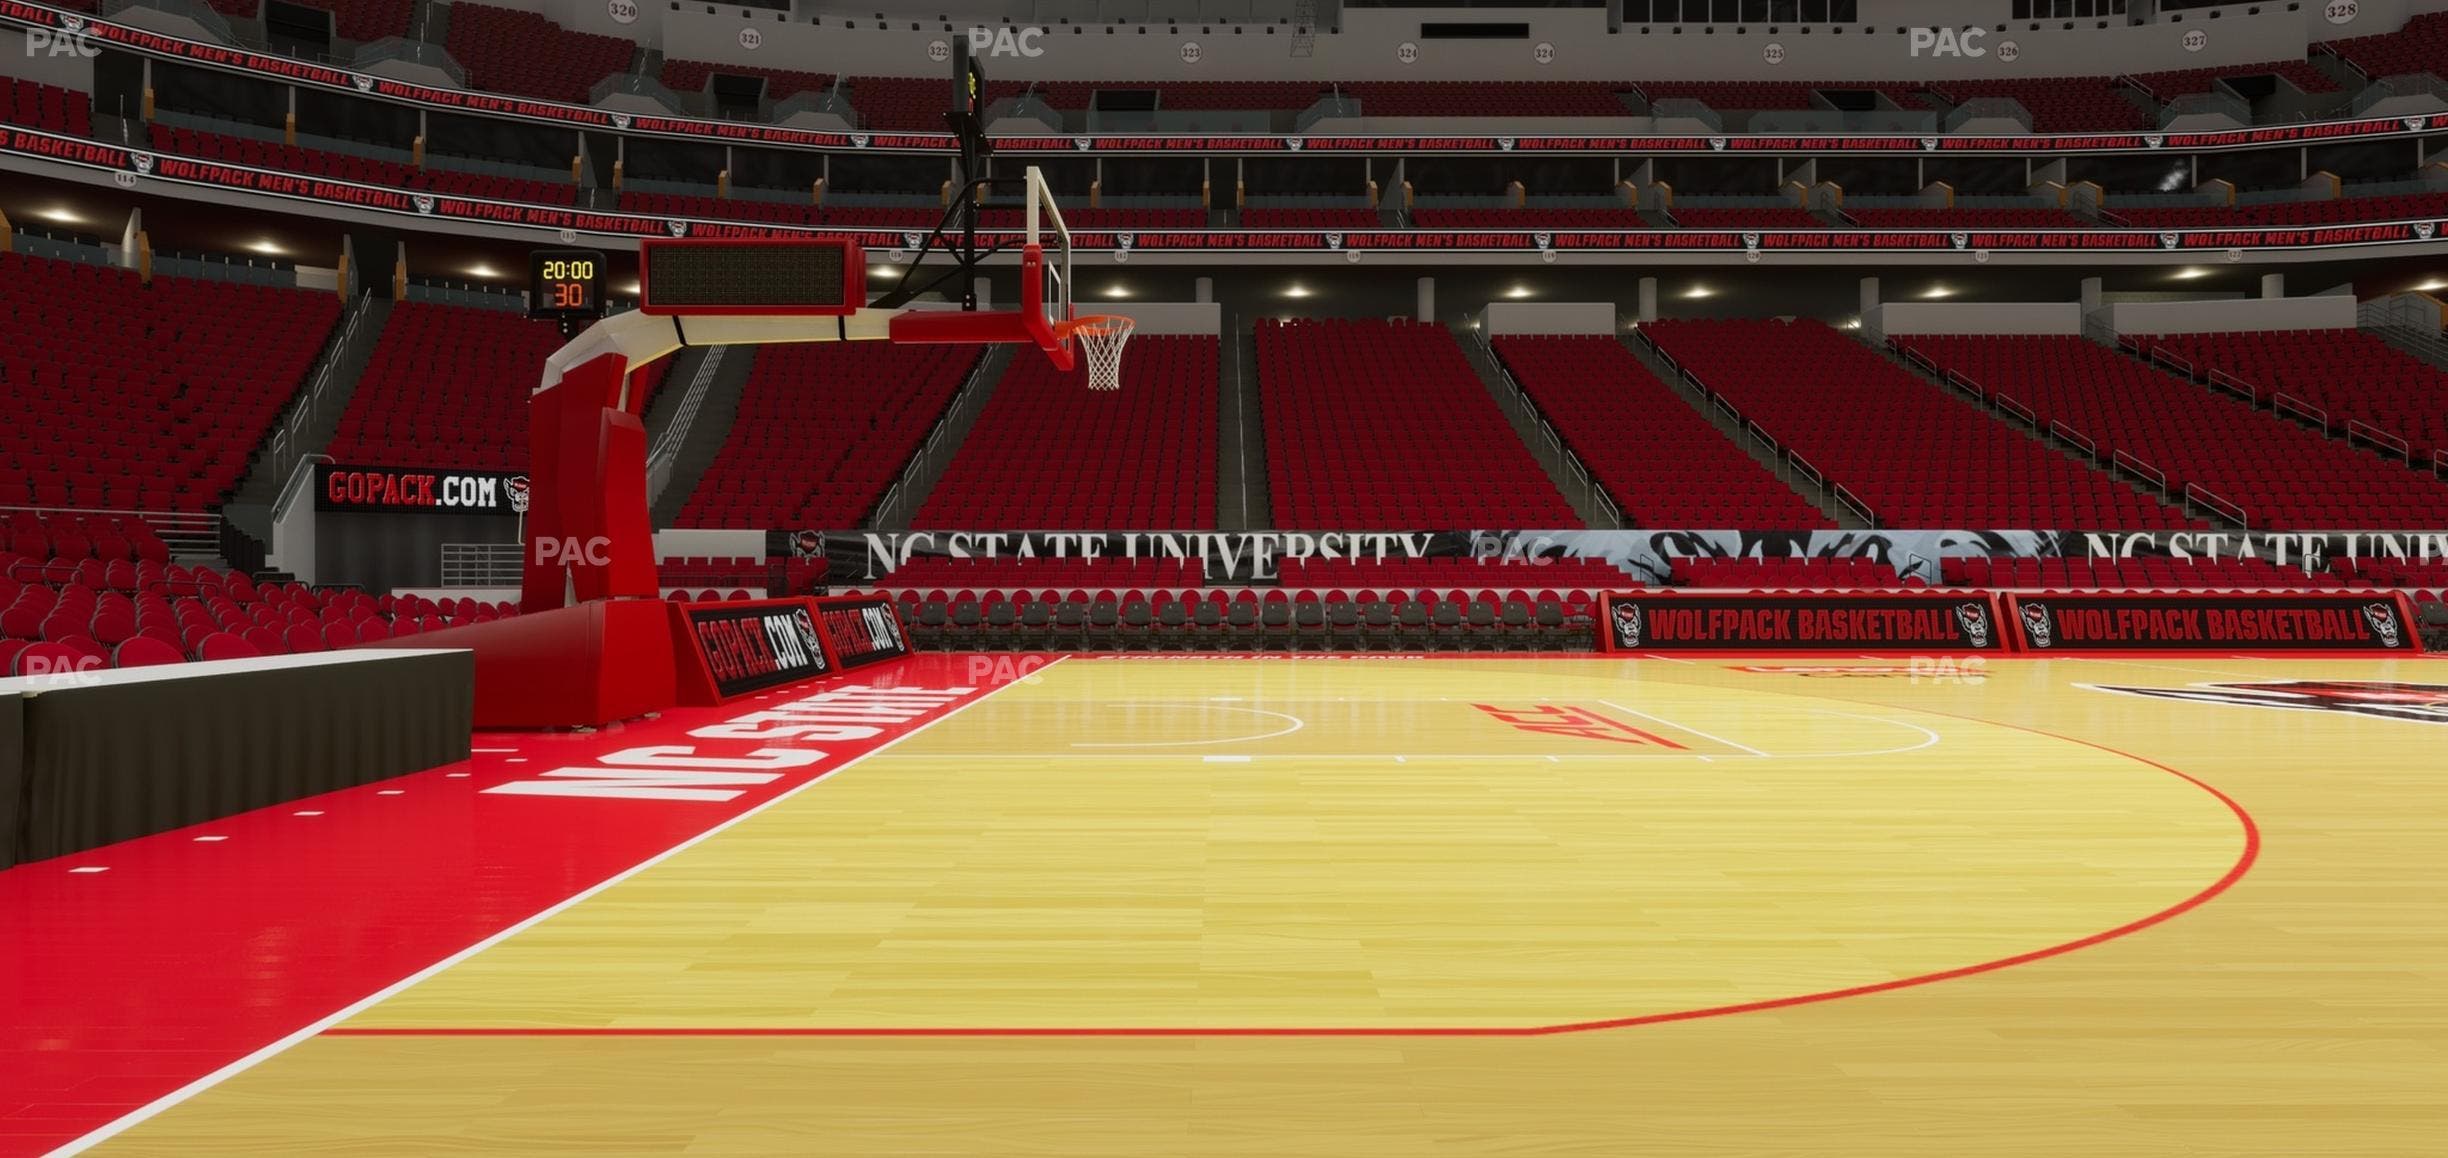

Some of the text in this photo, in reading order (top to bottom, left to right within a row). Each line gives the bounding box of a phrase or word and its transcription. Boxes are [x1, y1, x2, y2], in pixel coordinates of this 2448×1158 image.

[610, 5, 636, 18] 320
[2327, 3, 2357, 18] 328
[741, 32, 760, 45] 321
[2182, 34, 2205, 47] 327
[90, 21, 348, 86] WOLFPACK MEN'S BASKETBALL
[929, 46, 949, 57] 322
[1182, 47, 1200, 58] 323
[1399, 47, 1417, 58] 324
[1765, 47, 1784, 58] 325
[1999, 46, 2018, 57] 326
[377, 81, 608, 125] WOLFPACK MEN'S BASKETBALL
[635, 117, 848, 145] WOLFPACK MEN'S BASKETBALL
[2167, 119, 2400, 148] WOLFPACK MEN'S BASKETBALL
[13, 131, 126, 168] BASKETBALL
[873, 135, 949, 149] WOLFPACK
[995, 138, 1073, 150] BASKETBALL
[1094, 138, 1283, 150] WOLFPACK MEN'S BASKETBALL
[1306, 138, 1495, 151] WOLFPACK MEN'S BASKETBALL
[1518, 138, 1707, 150] WOLFPACK MEN'S BASKETBALL
[1730, 138, 1919, 150] WOLFPACK MEN'S BASKETBALL
[1941, 136, 2141, 150] WOLFPACK MEN'S BASKETBALL
[159, 159, 409, 209] WOLFPACK MEN'S BASKETBALL
[438, 199, 665, 235] WOLFPACK MEN'S BASKETBALL
[1137, 233, 1324, 249] WOLFPACK MEN'S BASKETBALL
[1345, 233, 1532, 248] WOLFPACK MEN'S BASKETBALL
[1554, 233, 1741, 248] WOLFPACK MEN'S BASKETBALL
[1762, 233, 1949, 249] WOLFPACK MEN'S BASKETBALL
[1971, 232, 2158, 249] WOLFPACK MEN'S BASKETBALL
[2182, 224, 2410, 248] WOLFPACK MEN'S BASKETBALL
[543, 261, 594, 281] 20:00
[555, 283, 583, 307] 30
[328, 471, 497, 508] GOPACK.COM
[822, 607, 894, 657] GOPACK.COM
[1648, 608, 1960, 641] WOLFPACK BASKETBALL
[2056, 608, 2370, 641] WOLFPACK BASKETBALL
[698, 614, 809, 681] GOPACK.COM
[480, 685, 979, 802] NC STATE
